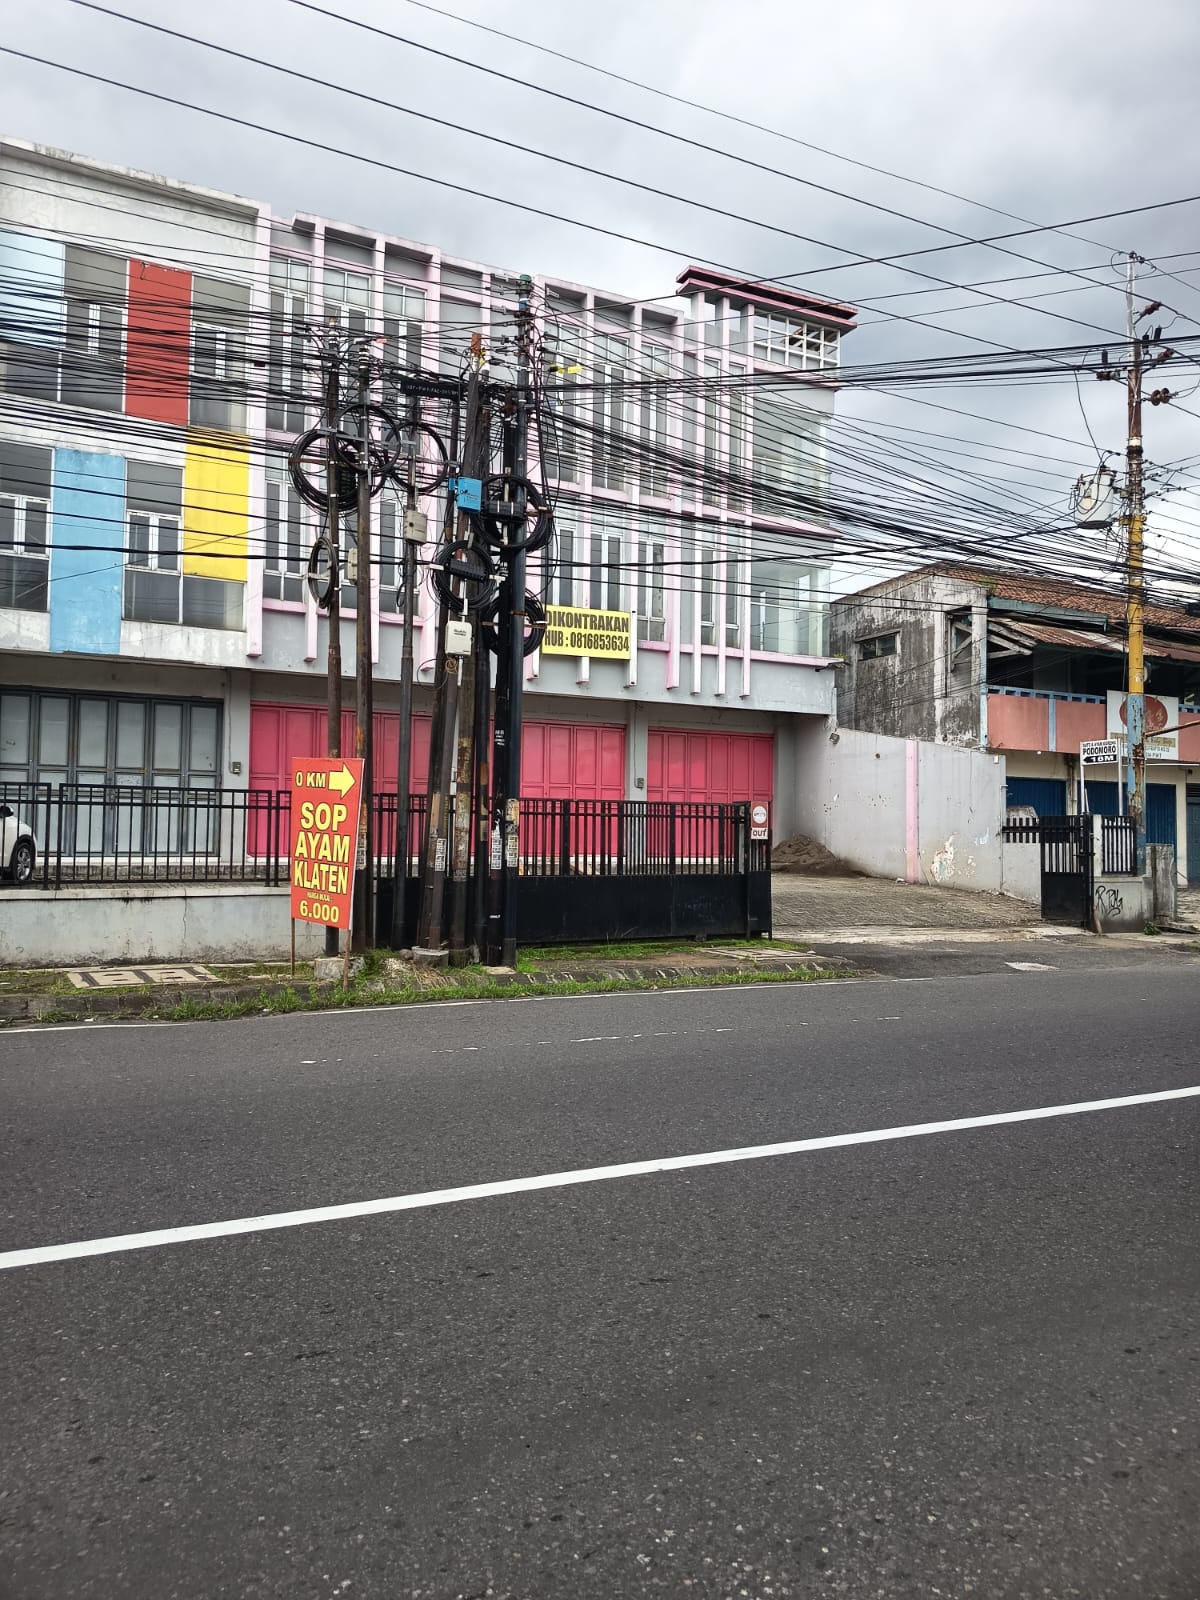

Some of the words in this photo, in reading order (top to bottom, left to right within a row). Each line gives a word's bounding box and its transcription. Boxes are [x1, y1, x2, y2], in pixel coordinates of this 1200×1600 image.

[546, 610, 629, 632] DIKONTRAKAN
[544, 630, 564, 647] HUB
[570, 631, 630, 652] 0816853634
[295, 771, 304, 787] 0
[306, 772, 327, 788] KM
[300, 801, 348, 832] SOP
[294, 830, 350, 864] AYAM
[293, 860, 349, 895] KLATEN
[299, 900, 340, 923] 6.000
